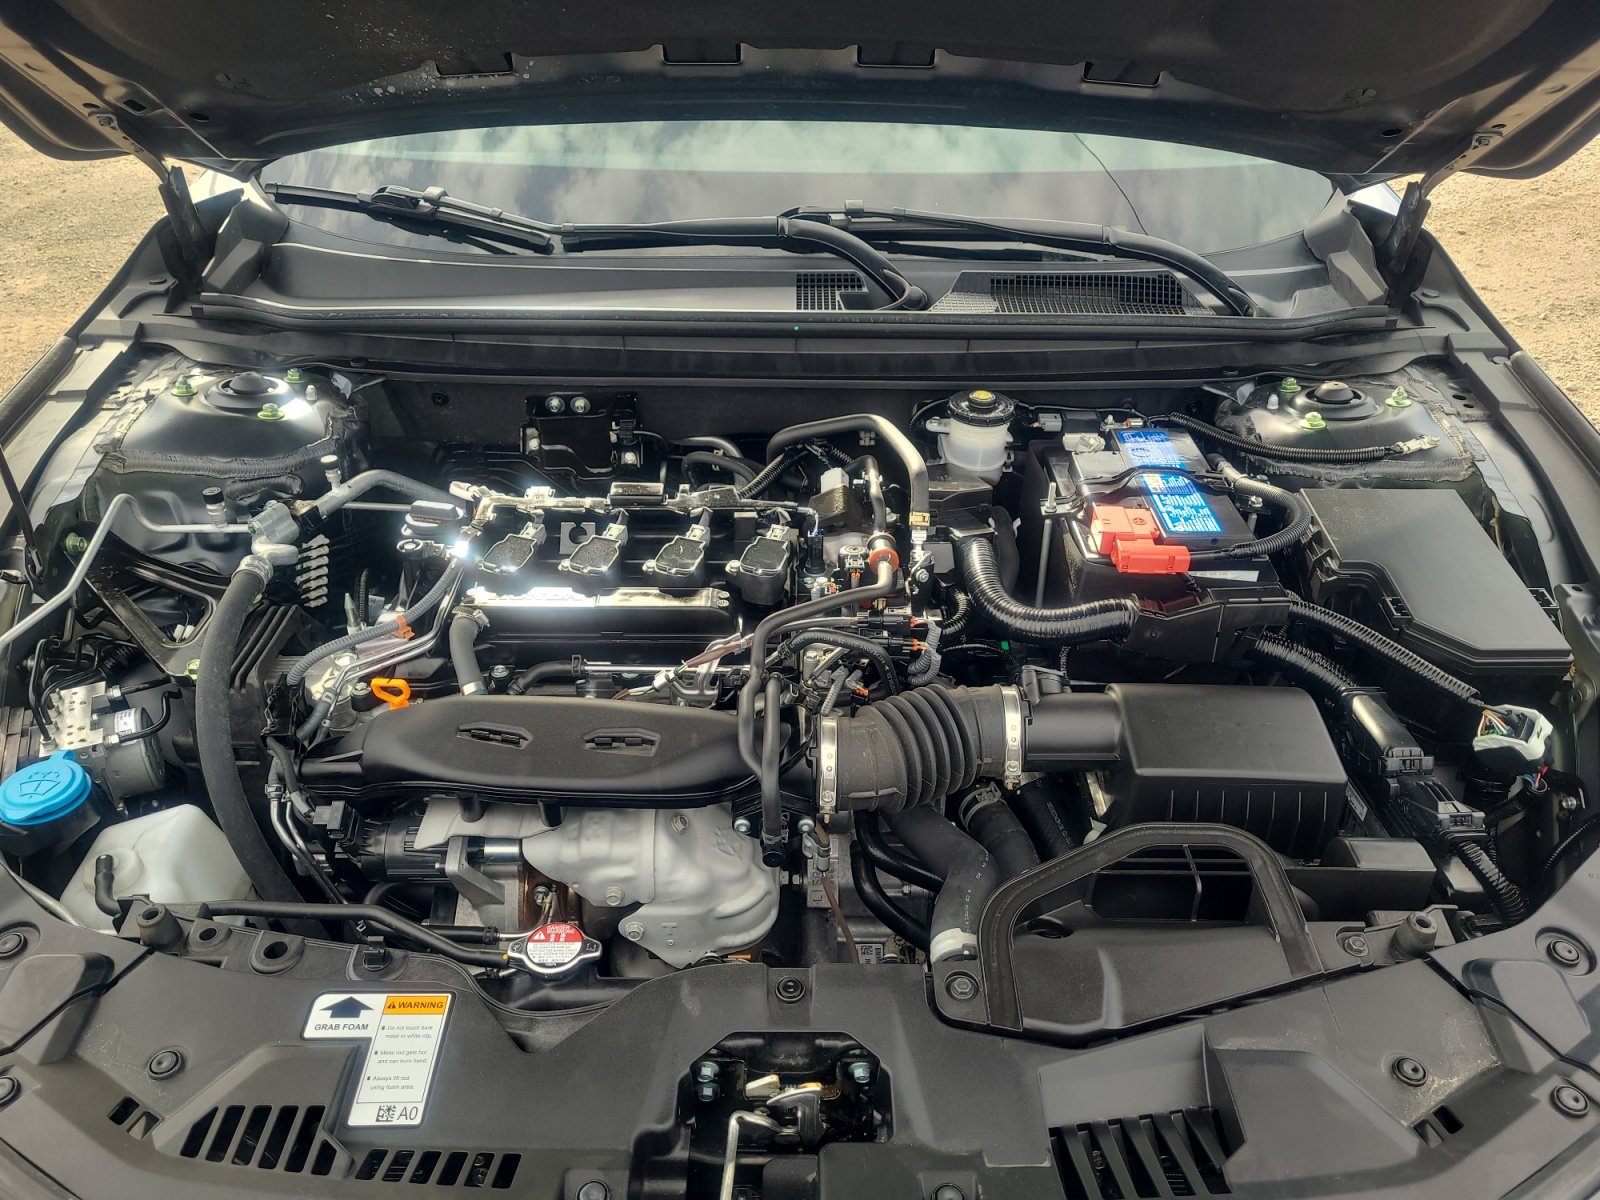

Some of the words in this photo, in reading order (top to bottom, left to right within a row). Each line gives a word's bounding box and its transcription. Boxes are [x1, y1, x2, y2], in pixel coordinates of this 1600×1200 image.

[398, 1001, 443, 1009] WARNING
[314, 1023, 340, 1031] GRAB
[342, 1023, 369, 1031] FOAM
[397, 1106, 418, 1121] A0
